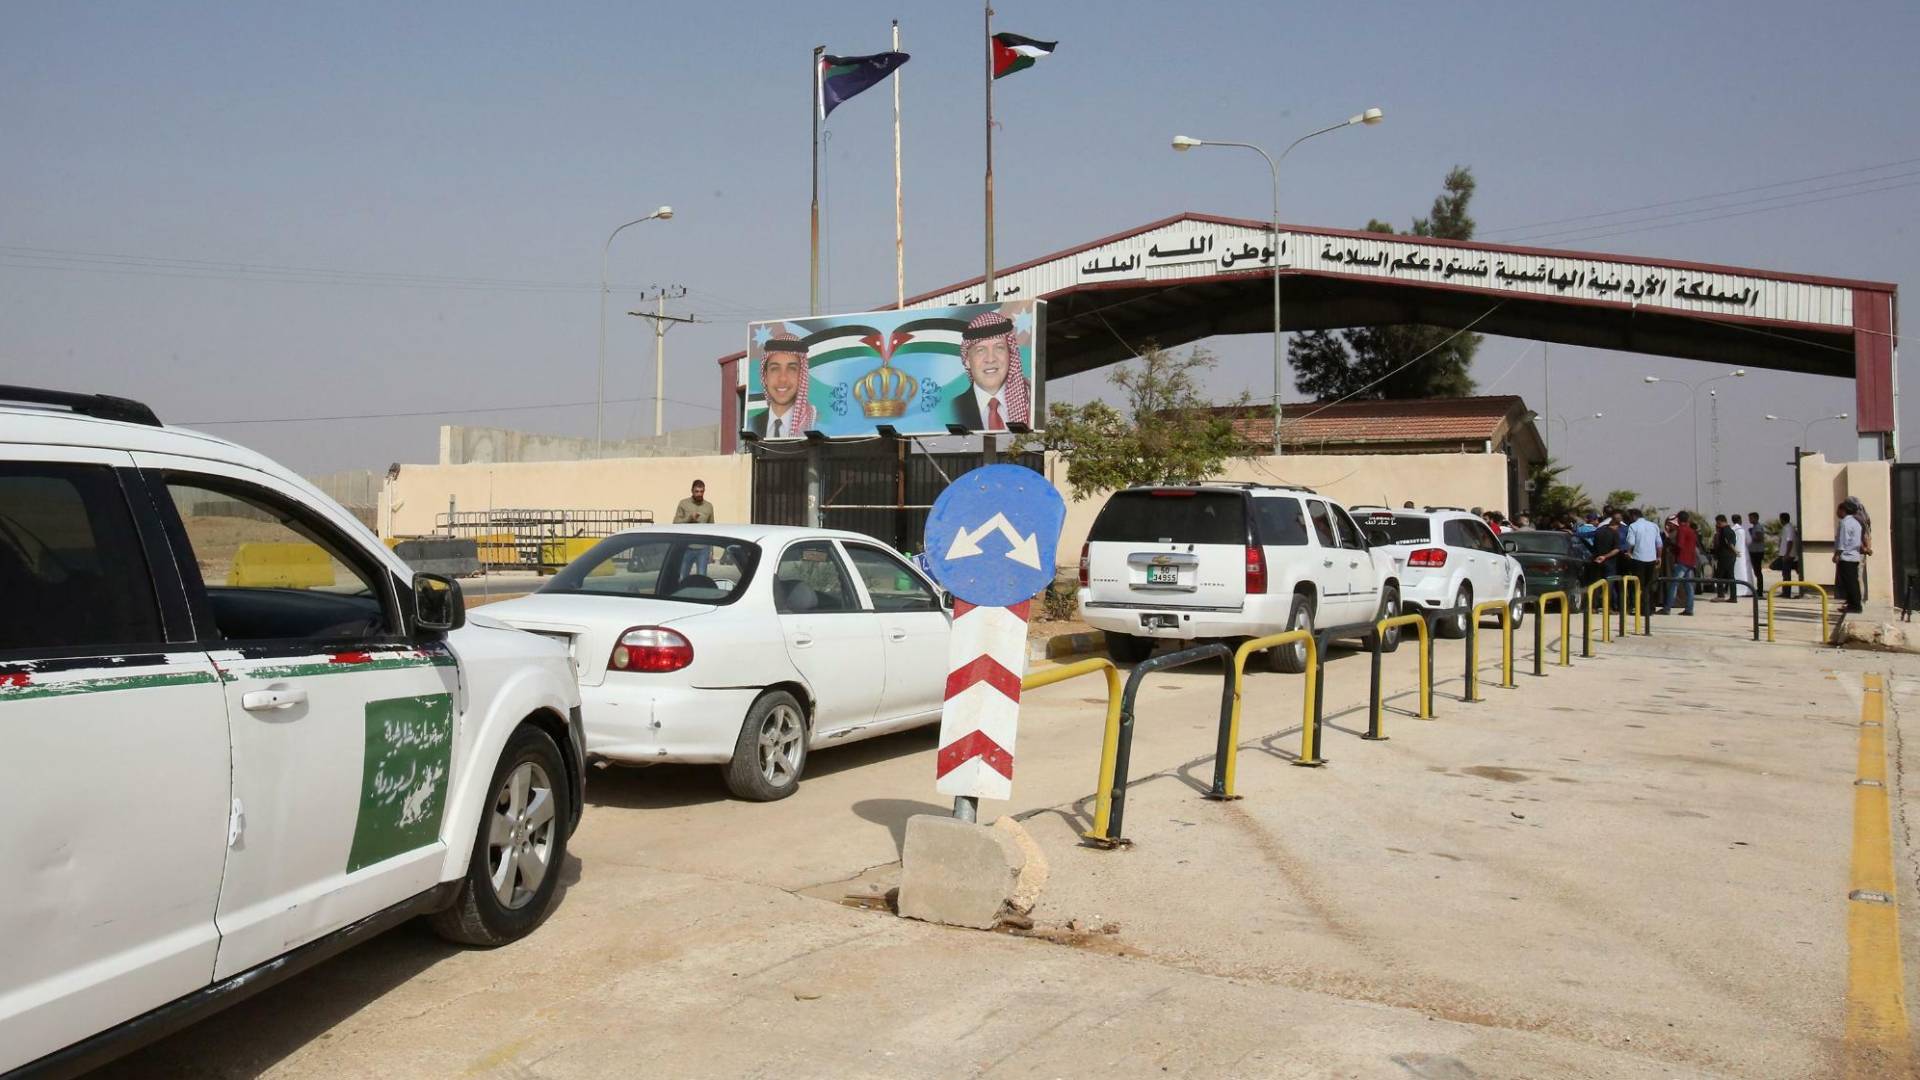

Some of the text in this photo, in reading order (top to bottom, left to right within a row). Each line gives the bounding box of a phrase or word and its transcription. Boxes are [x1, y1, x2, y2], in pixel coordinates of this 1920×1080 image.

[1149, 233, 1213, 257] الله
[1321, 243, 1389, 268] السلامة
[1081, 254, 1141, 275] الملك
[1496, 261, 1585, 291] الهاشمية
[1587, 267, 1666, 298] الأردنية
[1673, 277, 1759, 308] المملكة
